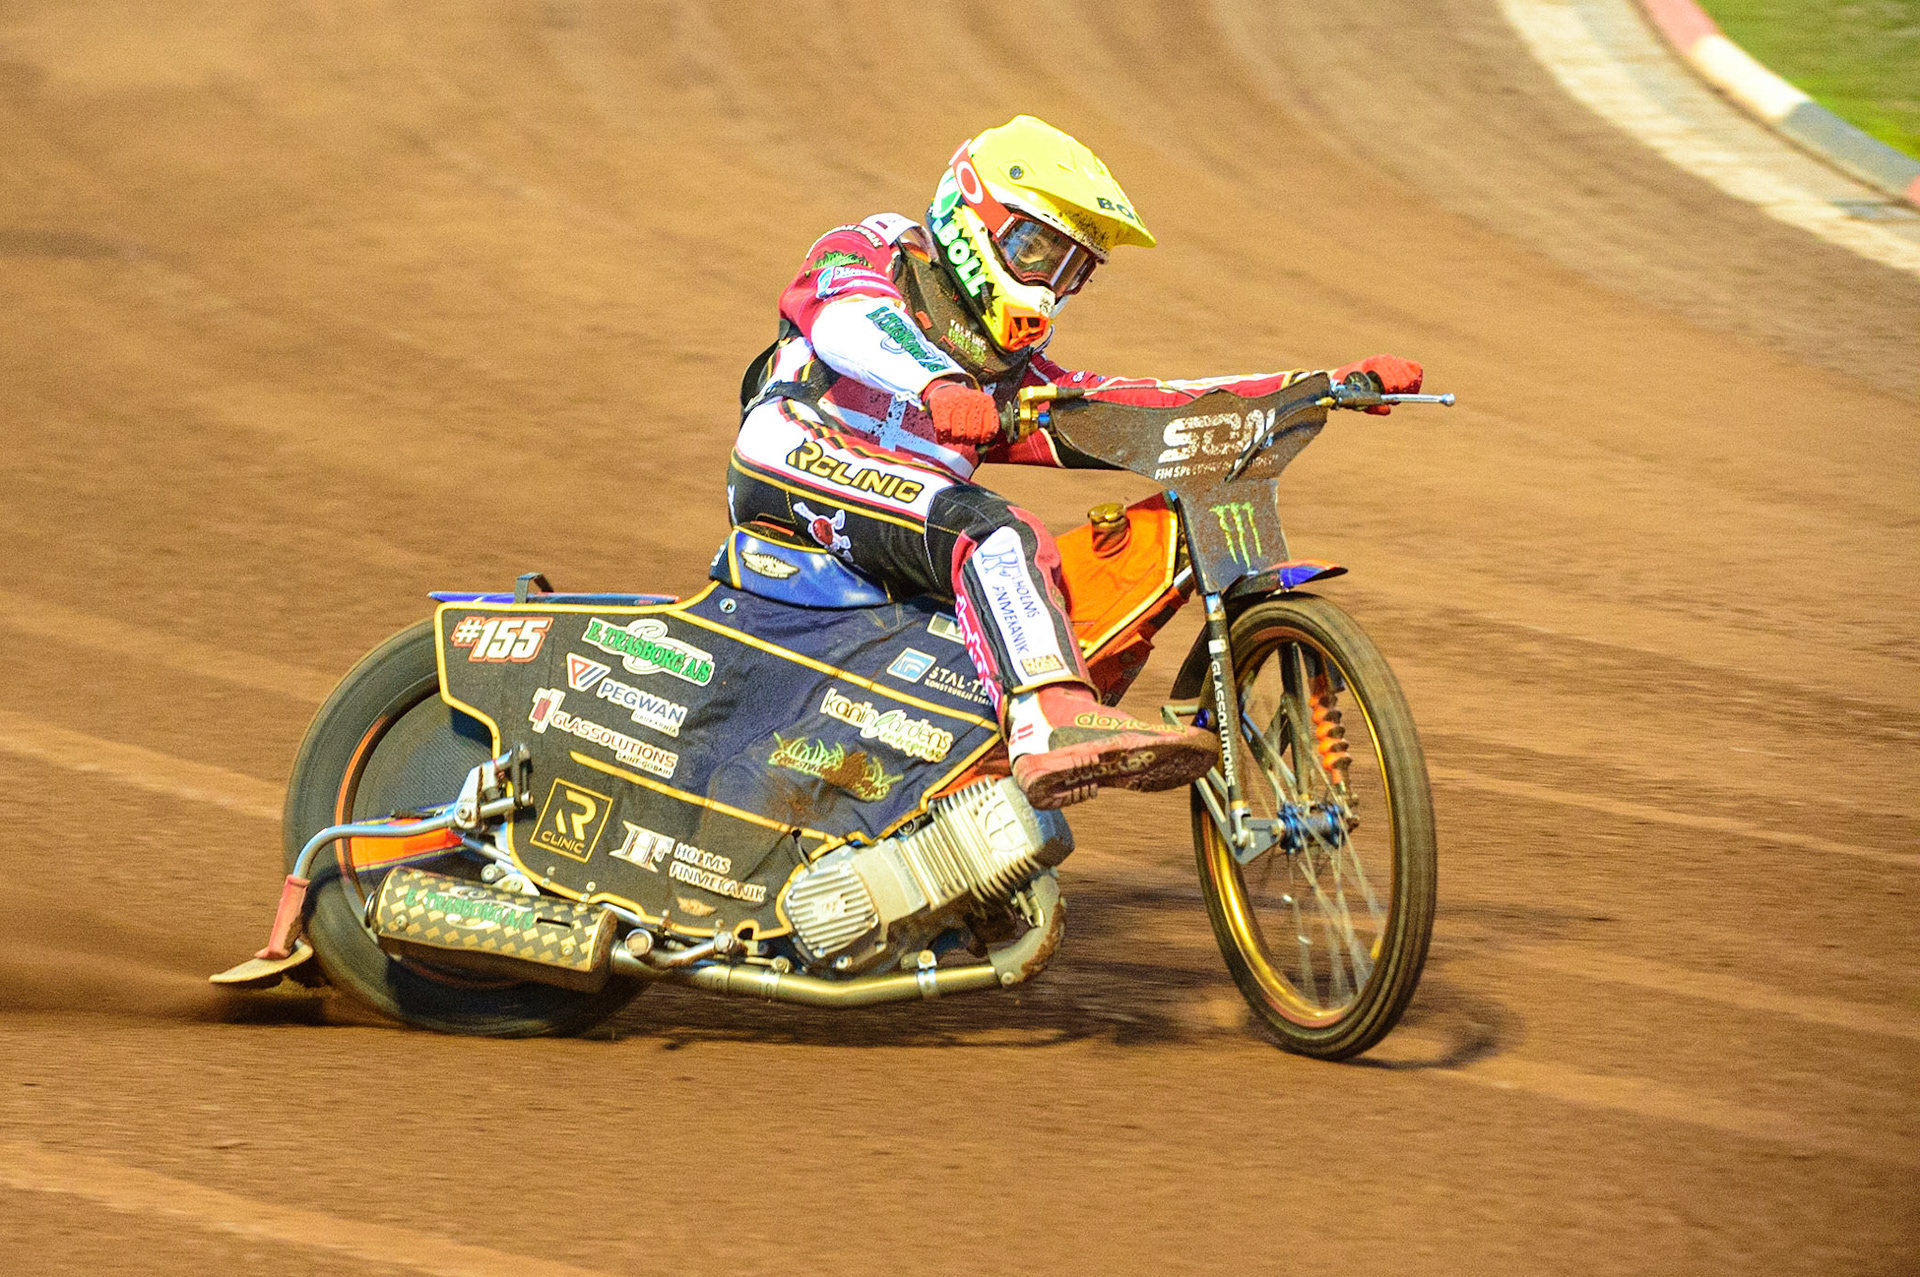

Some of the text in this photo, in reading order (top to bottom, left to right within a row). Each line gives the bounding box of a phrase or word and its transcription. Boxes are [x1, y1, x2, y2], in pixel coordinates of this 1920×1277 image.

[937, 220, 989, 297] BOLL
[453, 617, 552, 661] #155
[602, 626, 685, 673] TRASBORG
[681, 657, 713, 684] A/S
[600, 681, 684, 724] PEGWAN
[1211, 659, 1236, 788] GLASSOLUTIONS
[552, 713, 677, 769] GLASSOLUTIONS
[616, 752, 673, 777] SAINT-GOBAIN
[541, 830, 585, 854] CLINIC
[674, 842, 731, 874] HOLMS
[669, 861, 767, 902] FINMEKANIK
